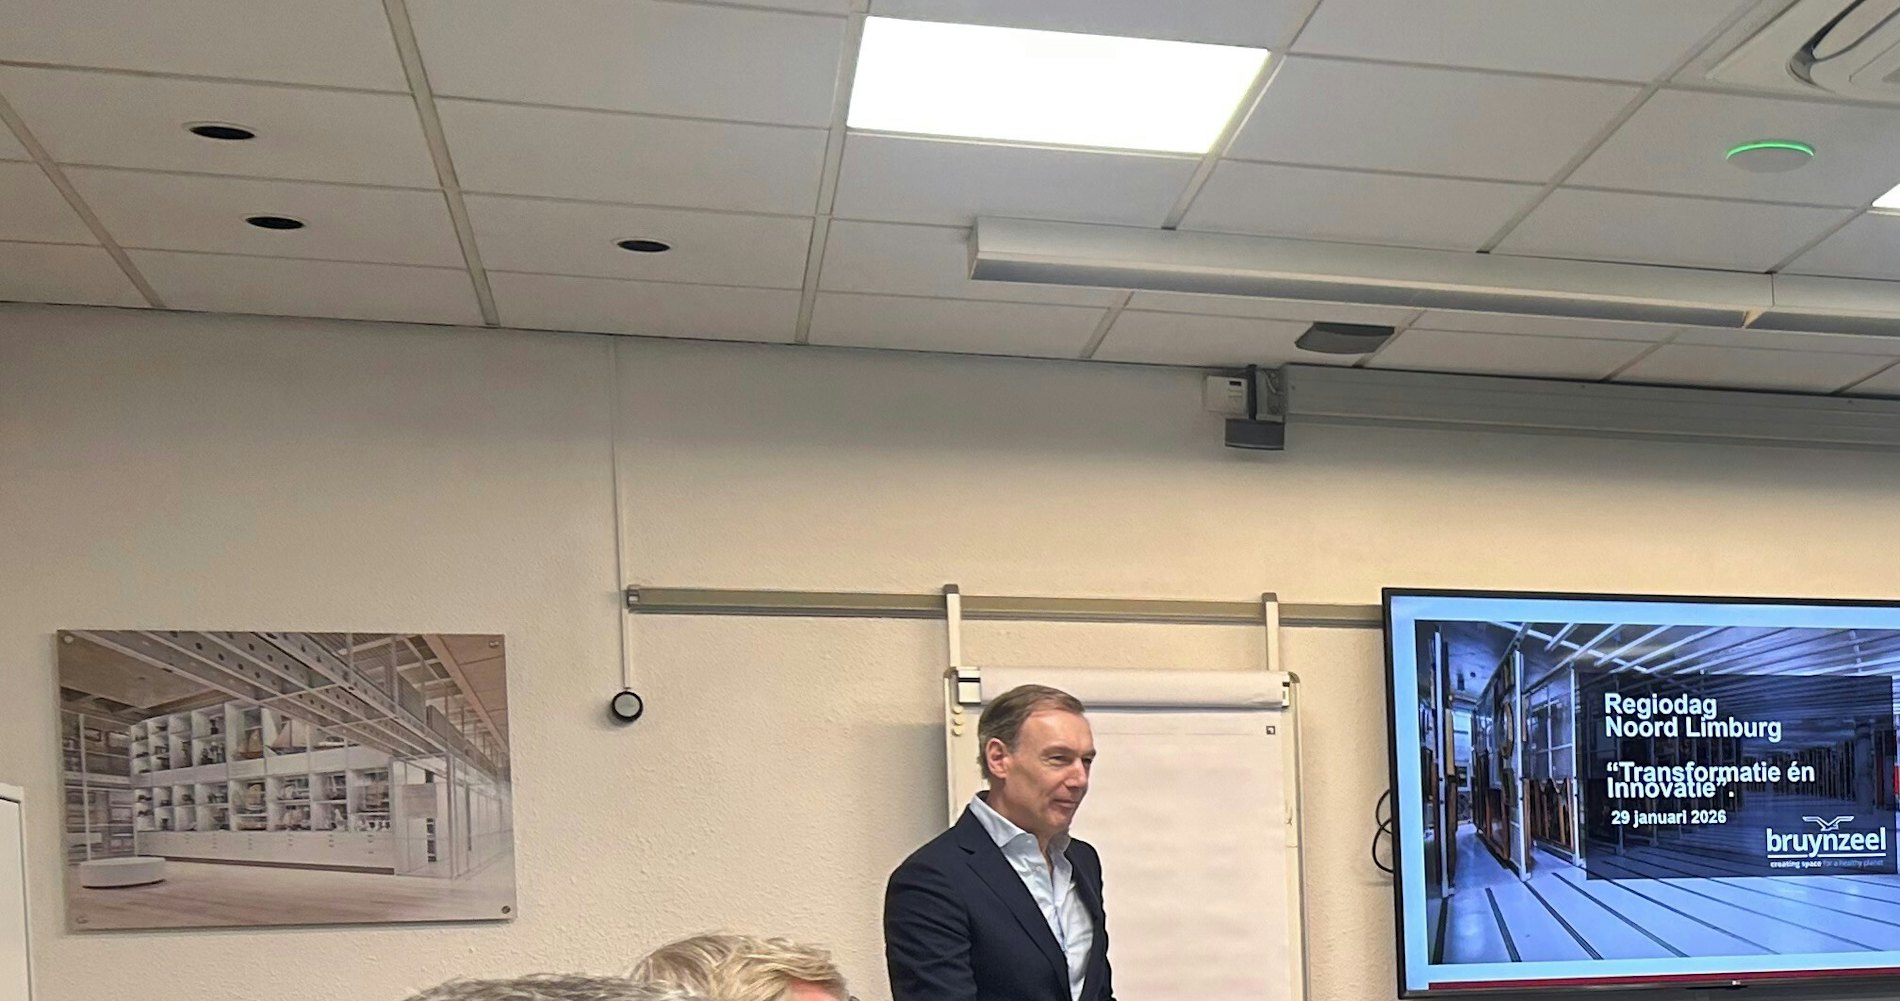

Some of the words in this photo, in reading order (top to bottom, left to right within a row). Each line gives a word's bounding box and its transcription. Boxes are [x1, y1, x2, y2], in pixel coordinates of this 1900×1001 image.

[1604, 692, 1717, 719] Regiodag
[1605, 715, 1678, 737] Noord
[1686, 715, 1782, 743] Limburg
[1787, 761, 1815, 783] én
[1611, 810, 1630, 825] 29
[1633, 810, 1687, 828] januari
[1691, 809, 1727, 825] 2026
[1766, 827, 1886, 858] bruynzeel
[1770, 860, 1800, 869] creating
[1802, 860, 1822, 869] space
